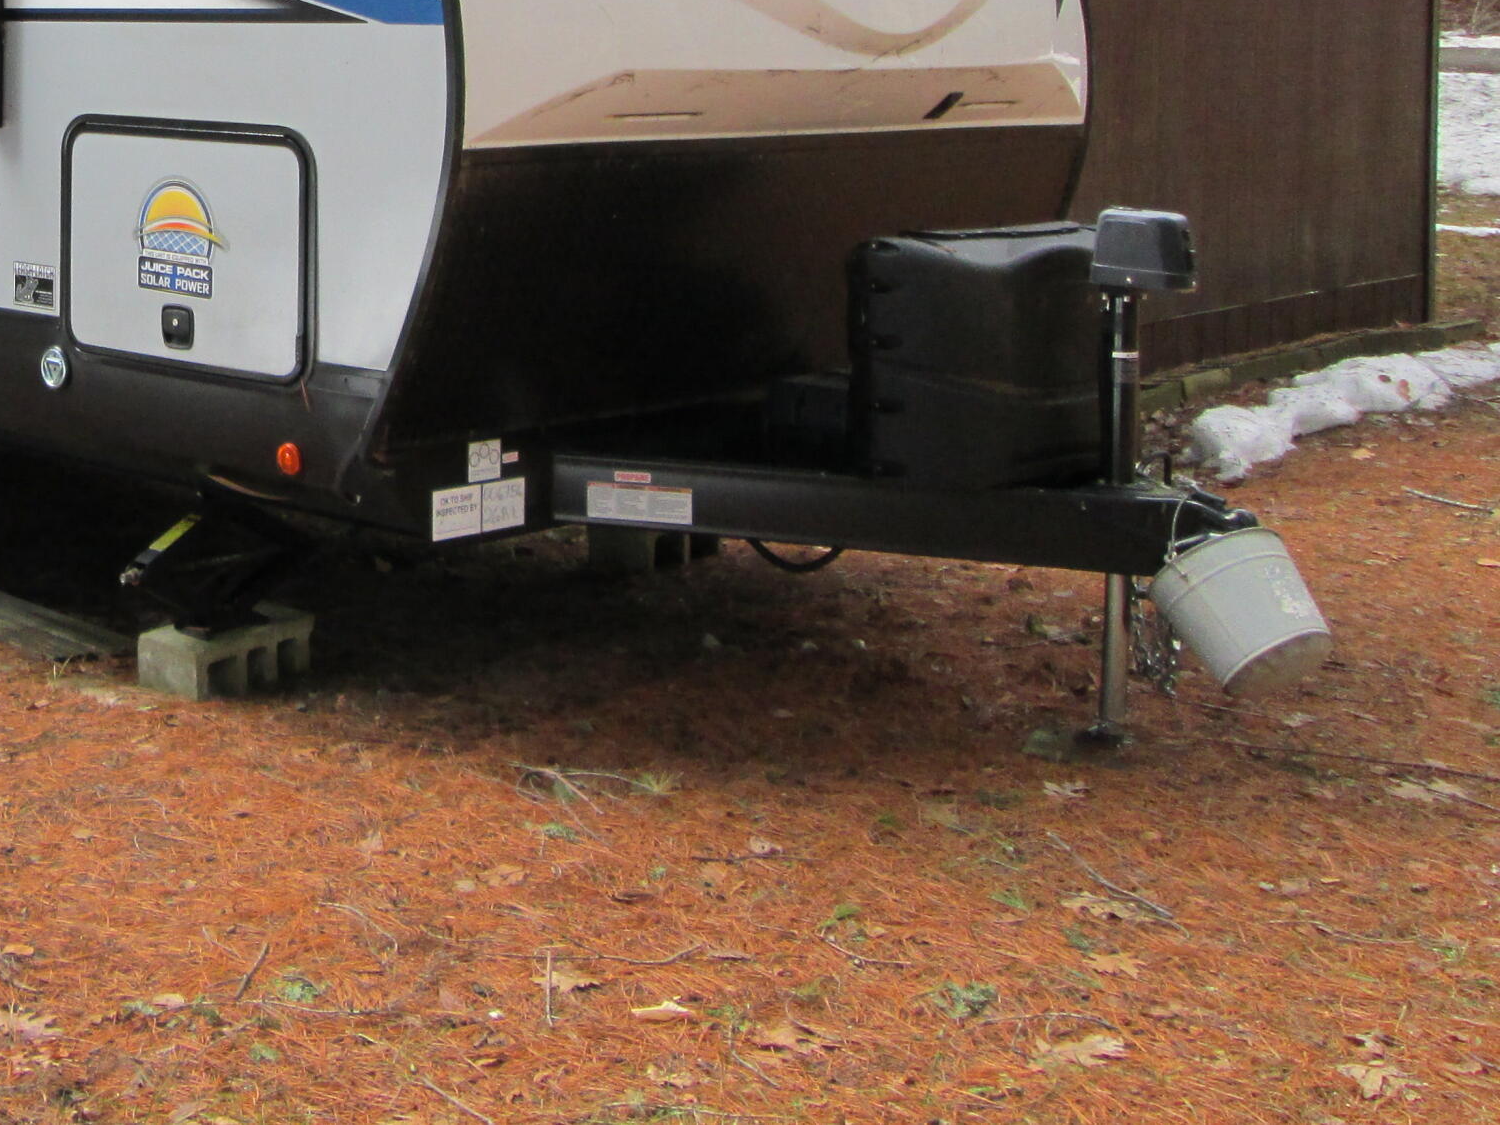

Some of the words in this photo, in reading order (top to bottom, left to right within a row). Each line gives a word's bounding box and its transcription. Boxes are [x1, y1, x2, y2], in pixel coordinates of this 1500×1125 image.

[141, 261, 174, 275] JUICE
[176, 266, 210, 281] PACK
[140, 273, 171, 288] SOLAR
[175, 279, 210, 294] POWER
